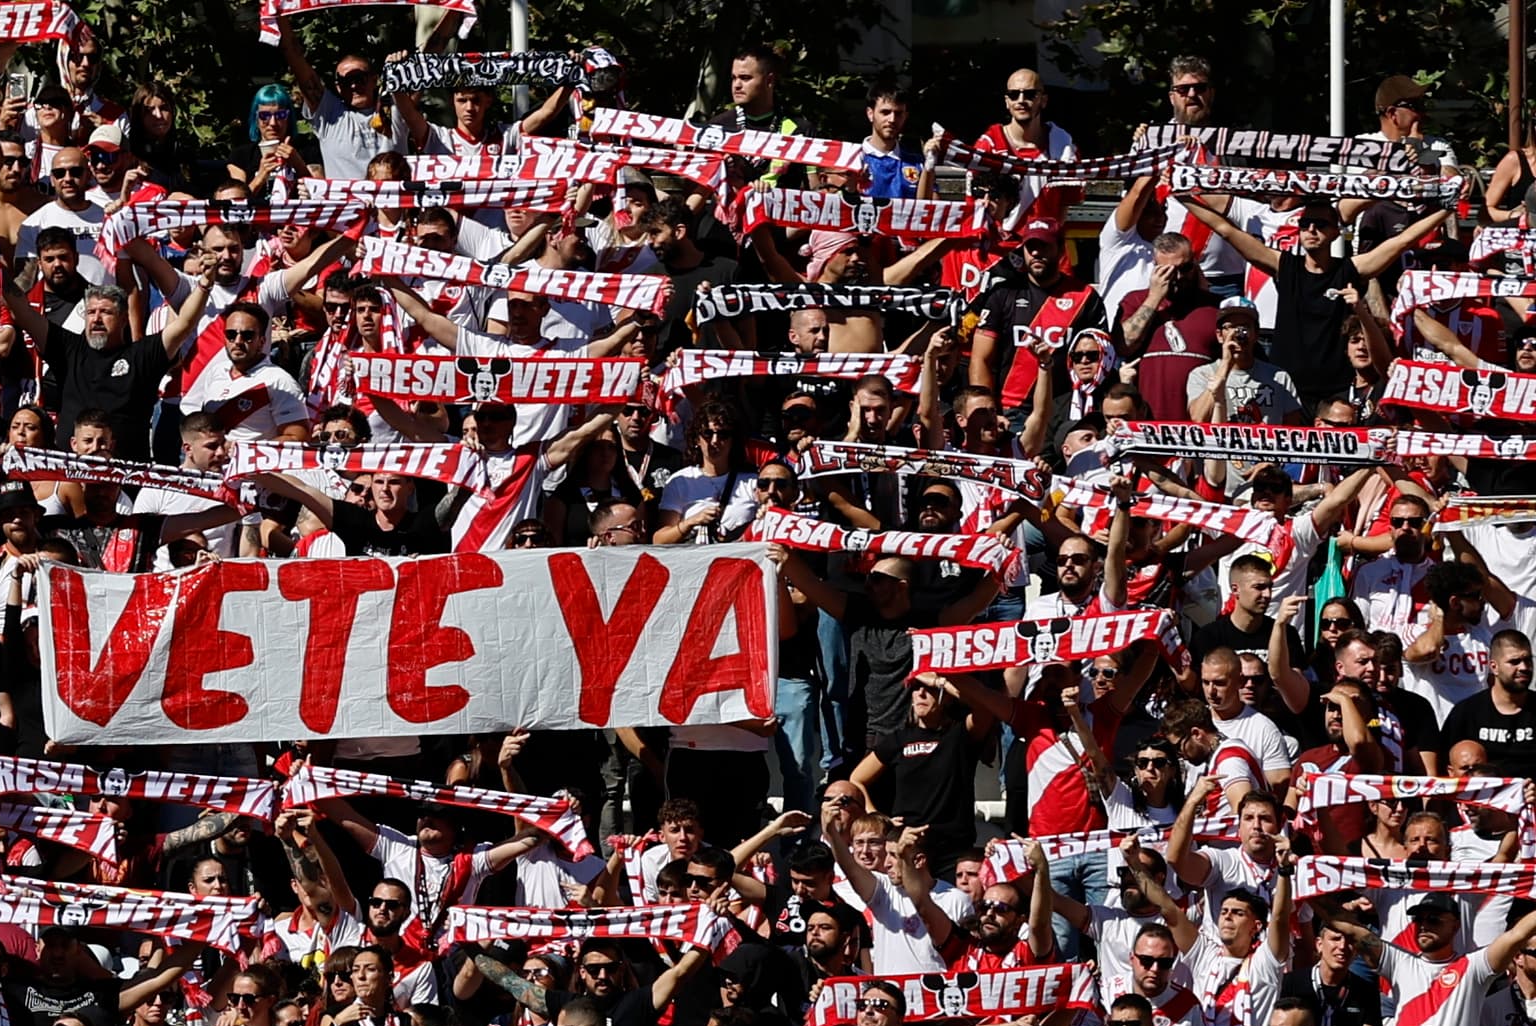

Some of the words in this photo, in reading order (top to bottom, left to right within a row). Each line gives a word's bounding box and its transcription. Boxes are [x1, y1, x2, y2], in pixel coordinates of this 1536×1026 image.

[738, 129, 830, 163] VETE
[744, 186, 842, 226] PRESA
[890, 198, 967, 233] VETE
[362, 235, 474, 287] PRESA
[524, 268, 615, 305] VETE
[614, 273, 663, 309] YA
[354, 356, 457, 397] PRESA
[512, 360, 602, 398] VETE
[600, 361, 641, 398] YA
[1139, 424, 1206, 449] RAYO
[1211, 425, 1359, 455] VALLECANO
[359, 442, 455, 480] VETE
[1145, 493, 1233, 529] VETE
[882, 530, 965, 559] VETE
[49, 551, 504, 735] VETE
[547, 552, 775, 725] YA
[910, 626, 1016, 673] PRESA
[1070, 612, 1150, 656] VETE
[1432, 650, 1490, 677] CCCP
[144, 770, 239, 811] VETE
[1429, 860, 1526, 892] VETE
[448, 906, 555, 944] PRESA
[606, 905, 690, 938] VETE
[978, 965, 1065, 1011] VETE
